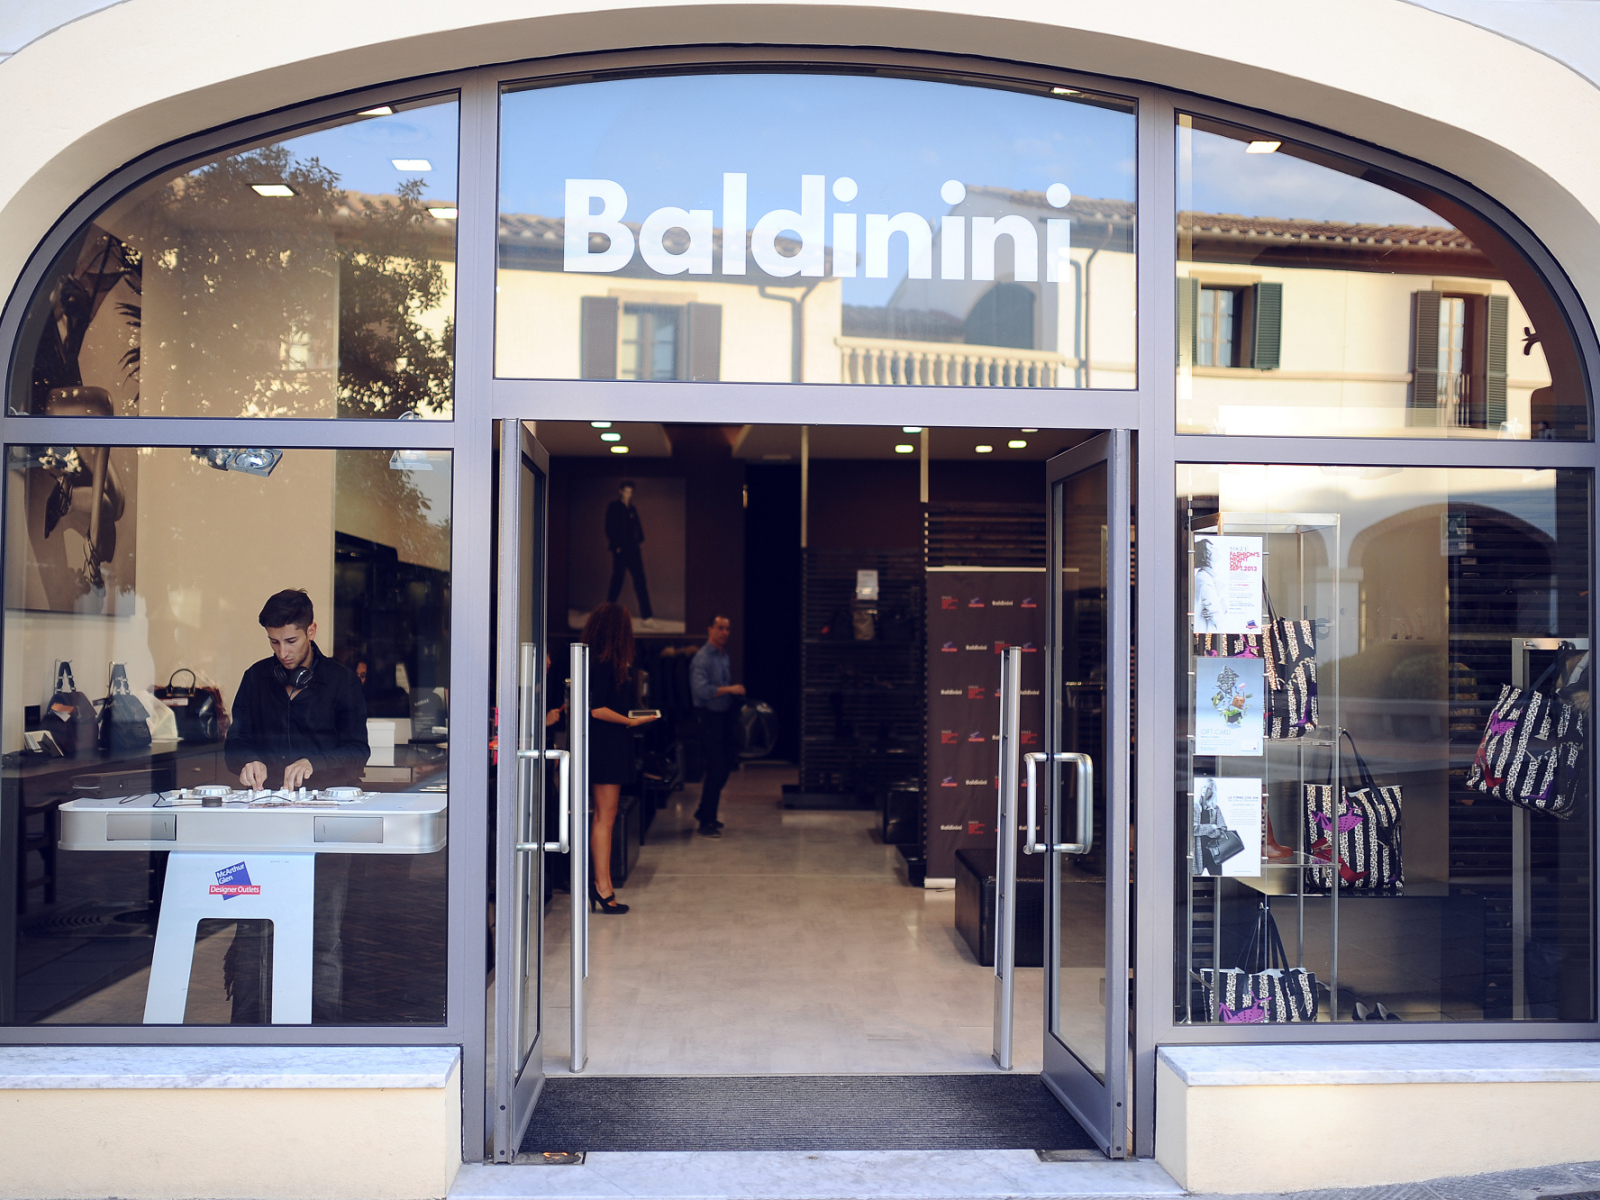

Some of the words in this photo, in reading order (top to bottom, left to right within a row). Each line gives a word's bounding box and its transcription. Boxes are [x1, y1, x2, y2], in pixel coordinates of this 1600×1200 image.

[563, 172, 1072, 283] Baldinini
[217, 864, 245, 879] McArthur
[219, 875, 234, 885] Glen
[210, 886, 237, 894] Designer
